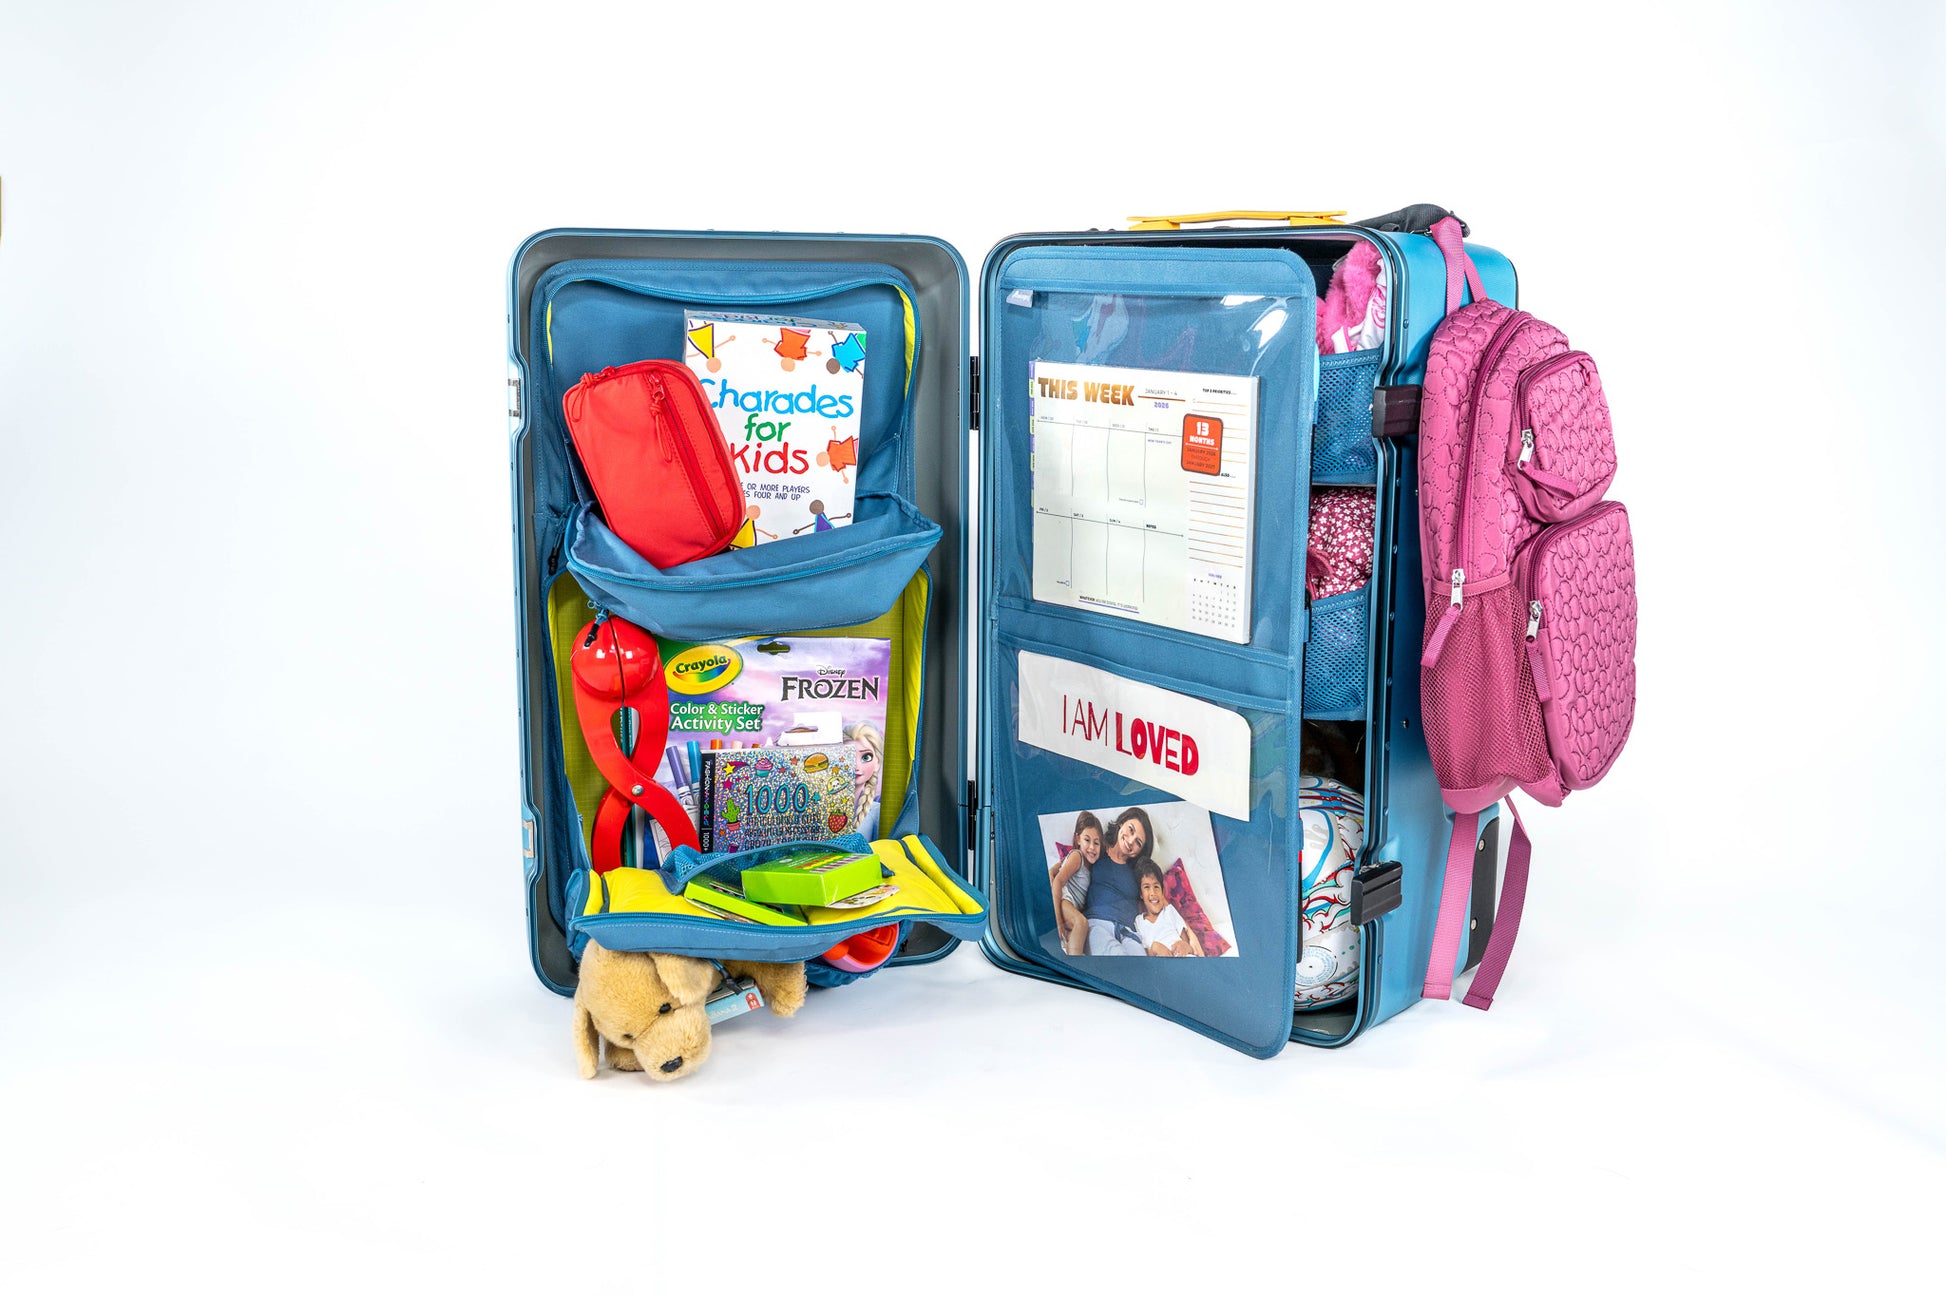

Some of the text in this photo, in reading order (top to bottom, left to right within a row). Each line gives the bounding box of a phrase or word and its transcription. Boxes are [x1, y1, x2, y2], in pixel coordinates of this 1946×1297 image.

[700, 378, 854, 418] Charades
[1038, 376, 1078, 400] THIS
[1084, 380, 1135, 407] WEEK
[744, 413, 791, 442] for
[1196, 421, 1209, 436] 13
[1189, 435, 1215, 446] MONTHS
[747, 482, 756, 490] OR
[760, 484, 779, 492] MORE
[782, 485, 810, 493] PLAYERS
[754, 491, 771, 499] FOUR
[676, 655, 727, 673] Crayola
[781, 676, 879, 701] FROZEN
[670, 703, 763, 714] Color & Sticker
[671, 716, 760, 732] Activity Set
[1063, 694, 1199, 776] I AM LOVED
